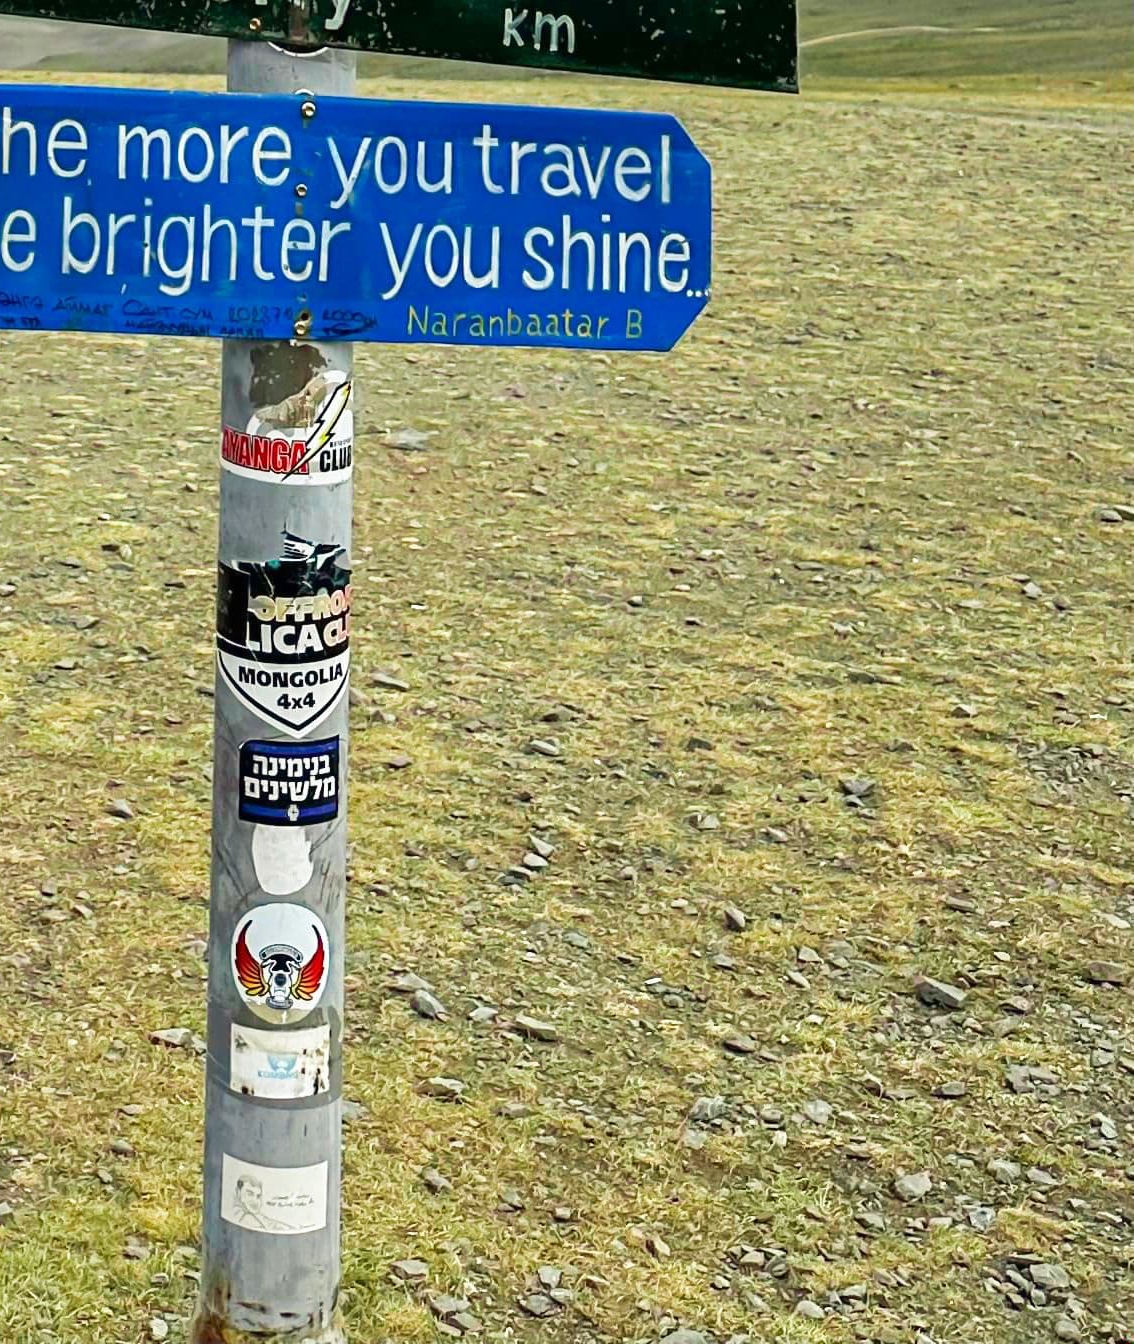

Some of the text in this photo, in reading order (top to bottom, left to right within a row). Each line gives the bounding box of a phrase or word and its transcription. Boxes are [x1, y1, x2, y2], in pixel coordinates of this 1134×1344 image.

[115, 123, 293, 185] more
[328, 137, 455, 209] you
[473, 123, 672, 205] travel
[61, 194, 352, 297] brighter
[381, 222, 503, 300] you
[406, 303, 613, 341] Naranbaatar
[626, 308, 643, 339] B
[222, 426, 309, 475] AYANGA
[251, 584, 353, 623] OFFRO
[238, 662, 343, 688] MONGOLIA
[277, 692, 316, 710] 4x4
[252, 754, 331, 777] בנימינה
[244, 775, 336, 802] מלשינים
